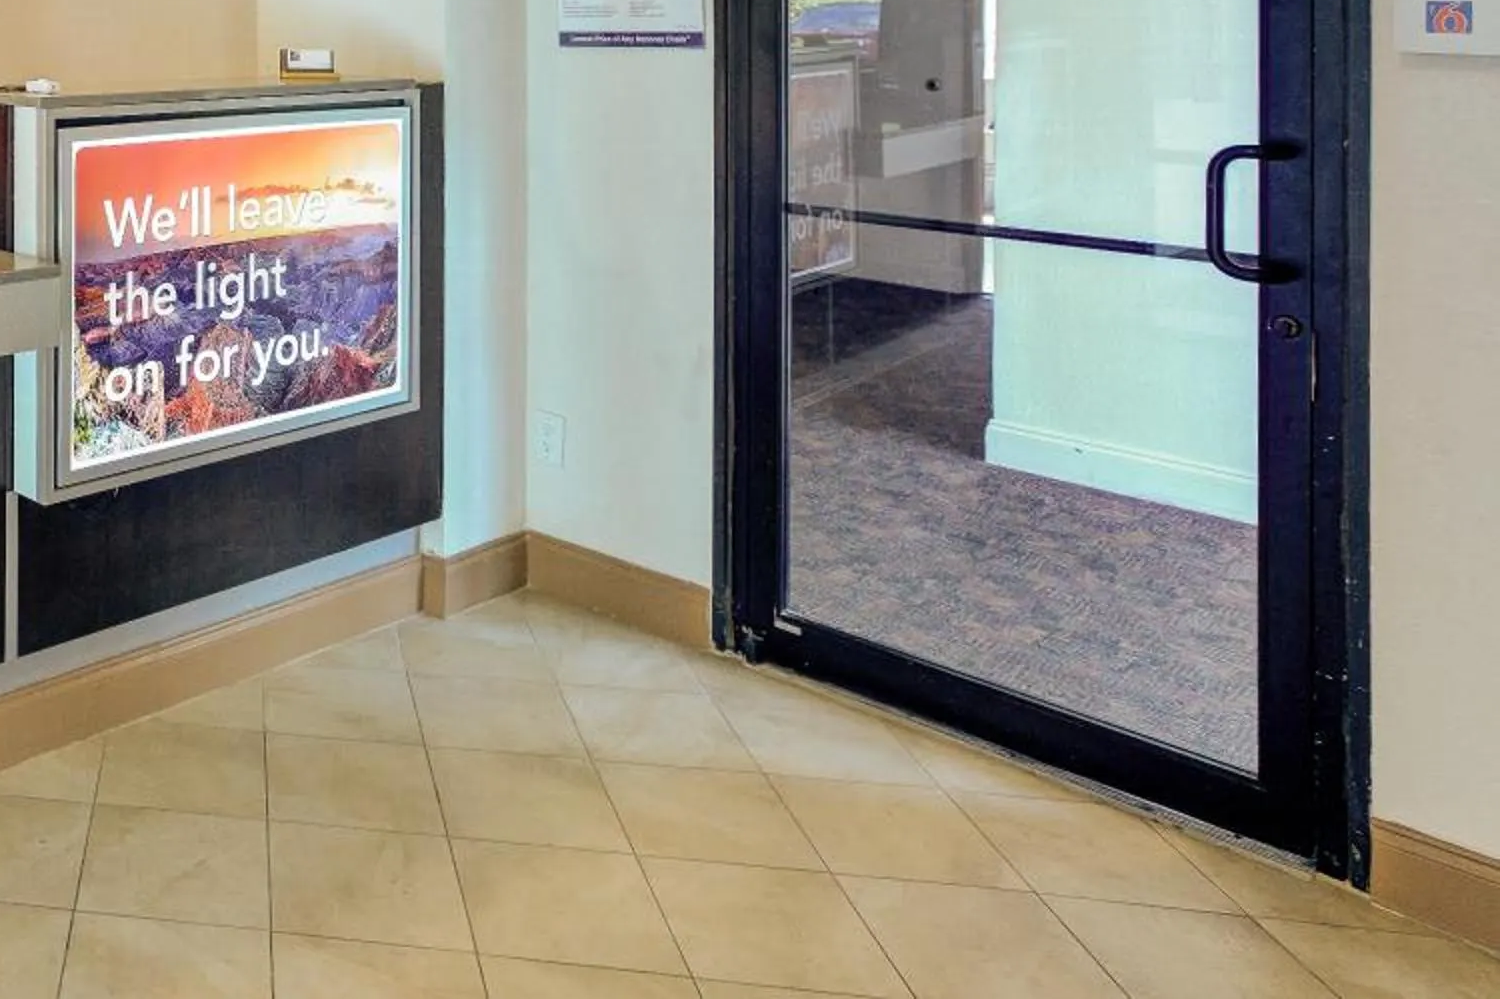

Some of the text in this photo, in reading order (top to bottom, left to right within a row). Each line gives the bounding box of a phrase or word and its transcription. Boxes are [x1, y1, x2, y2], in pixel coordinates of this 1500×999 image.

[103, 184, 326, 248] We'll leave
[103, 253, 287, 326] the light
[105, 328, 329, 401] on for you.
